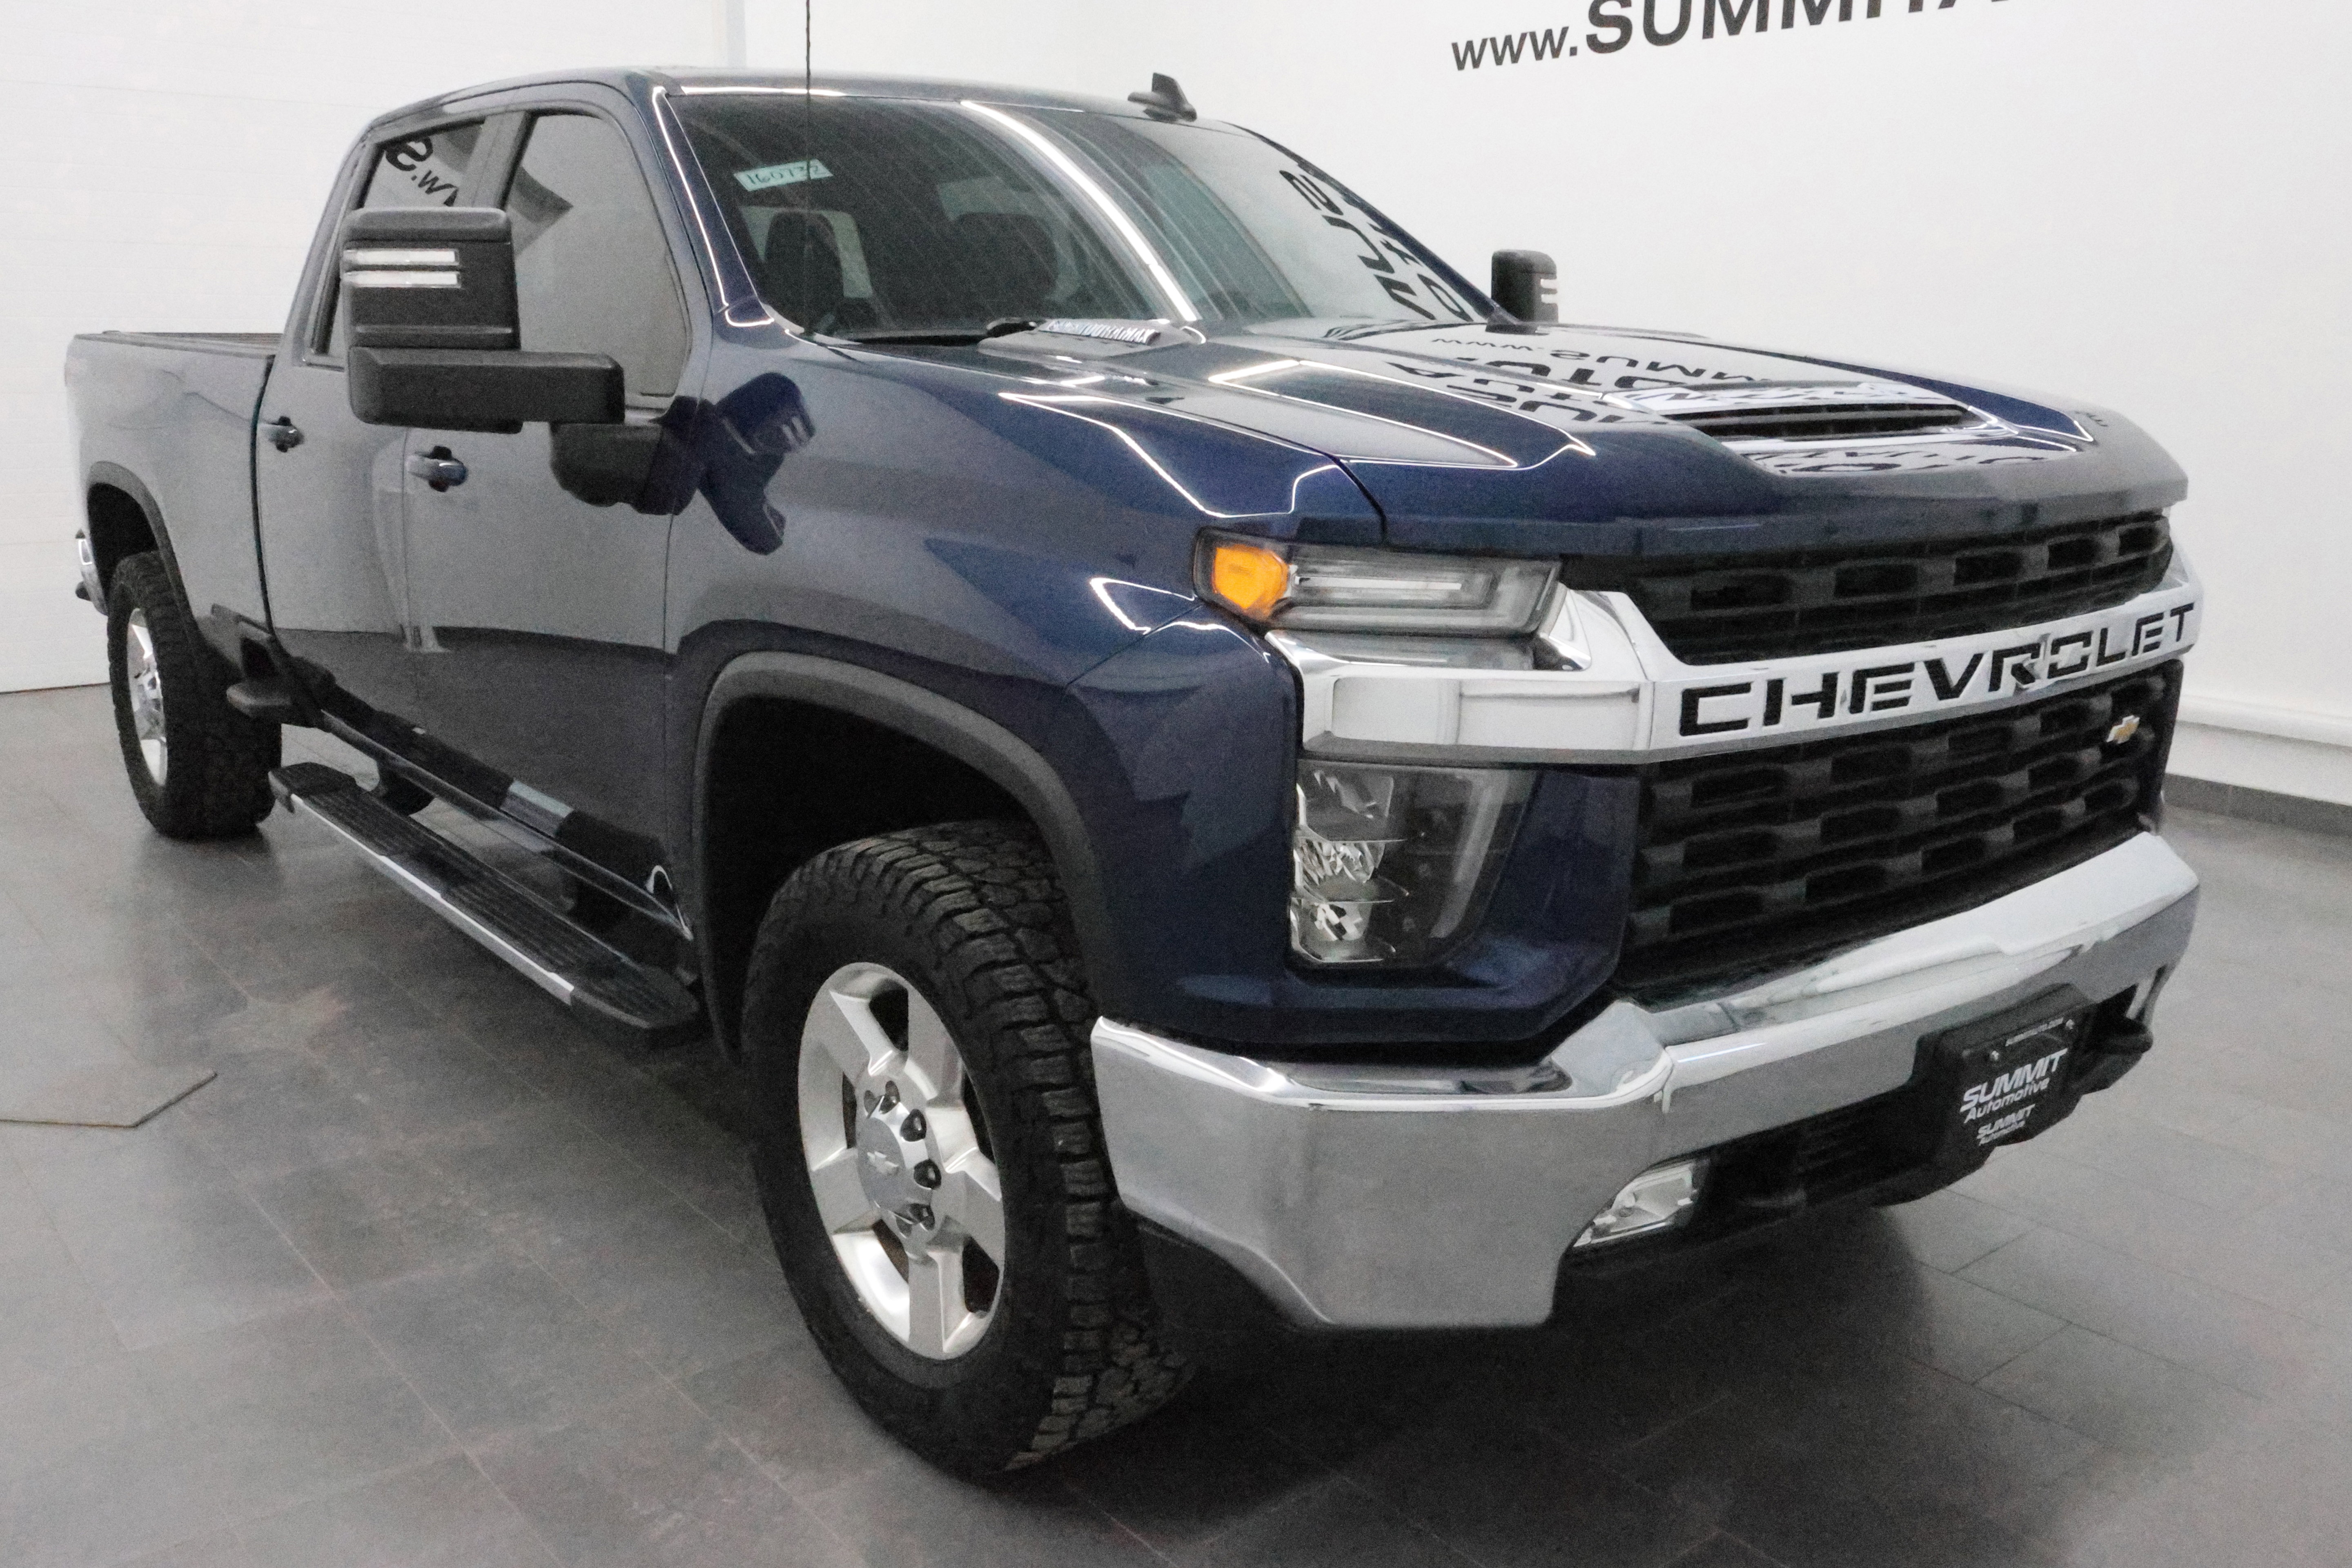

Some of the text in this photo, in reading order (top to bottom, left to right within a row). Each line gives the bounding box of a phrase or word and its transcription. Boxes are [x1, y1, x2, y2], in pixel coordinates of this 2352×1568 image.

[1679, 603, 2194, 736] CHEVROLET
[1960, 1048, 2068, 1112] SUMMIT
[1964, 1078, 2050, 1123] Automotive
[1977, 1104, 2036, 1139] SUMMIT
